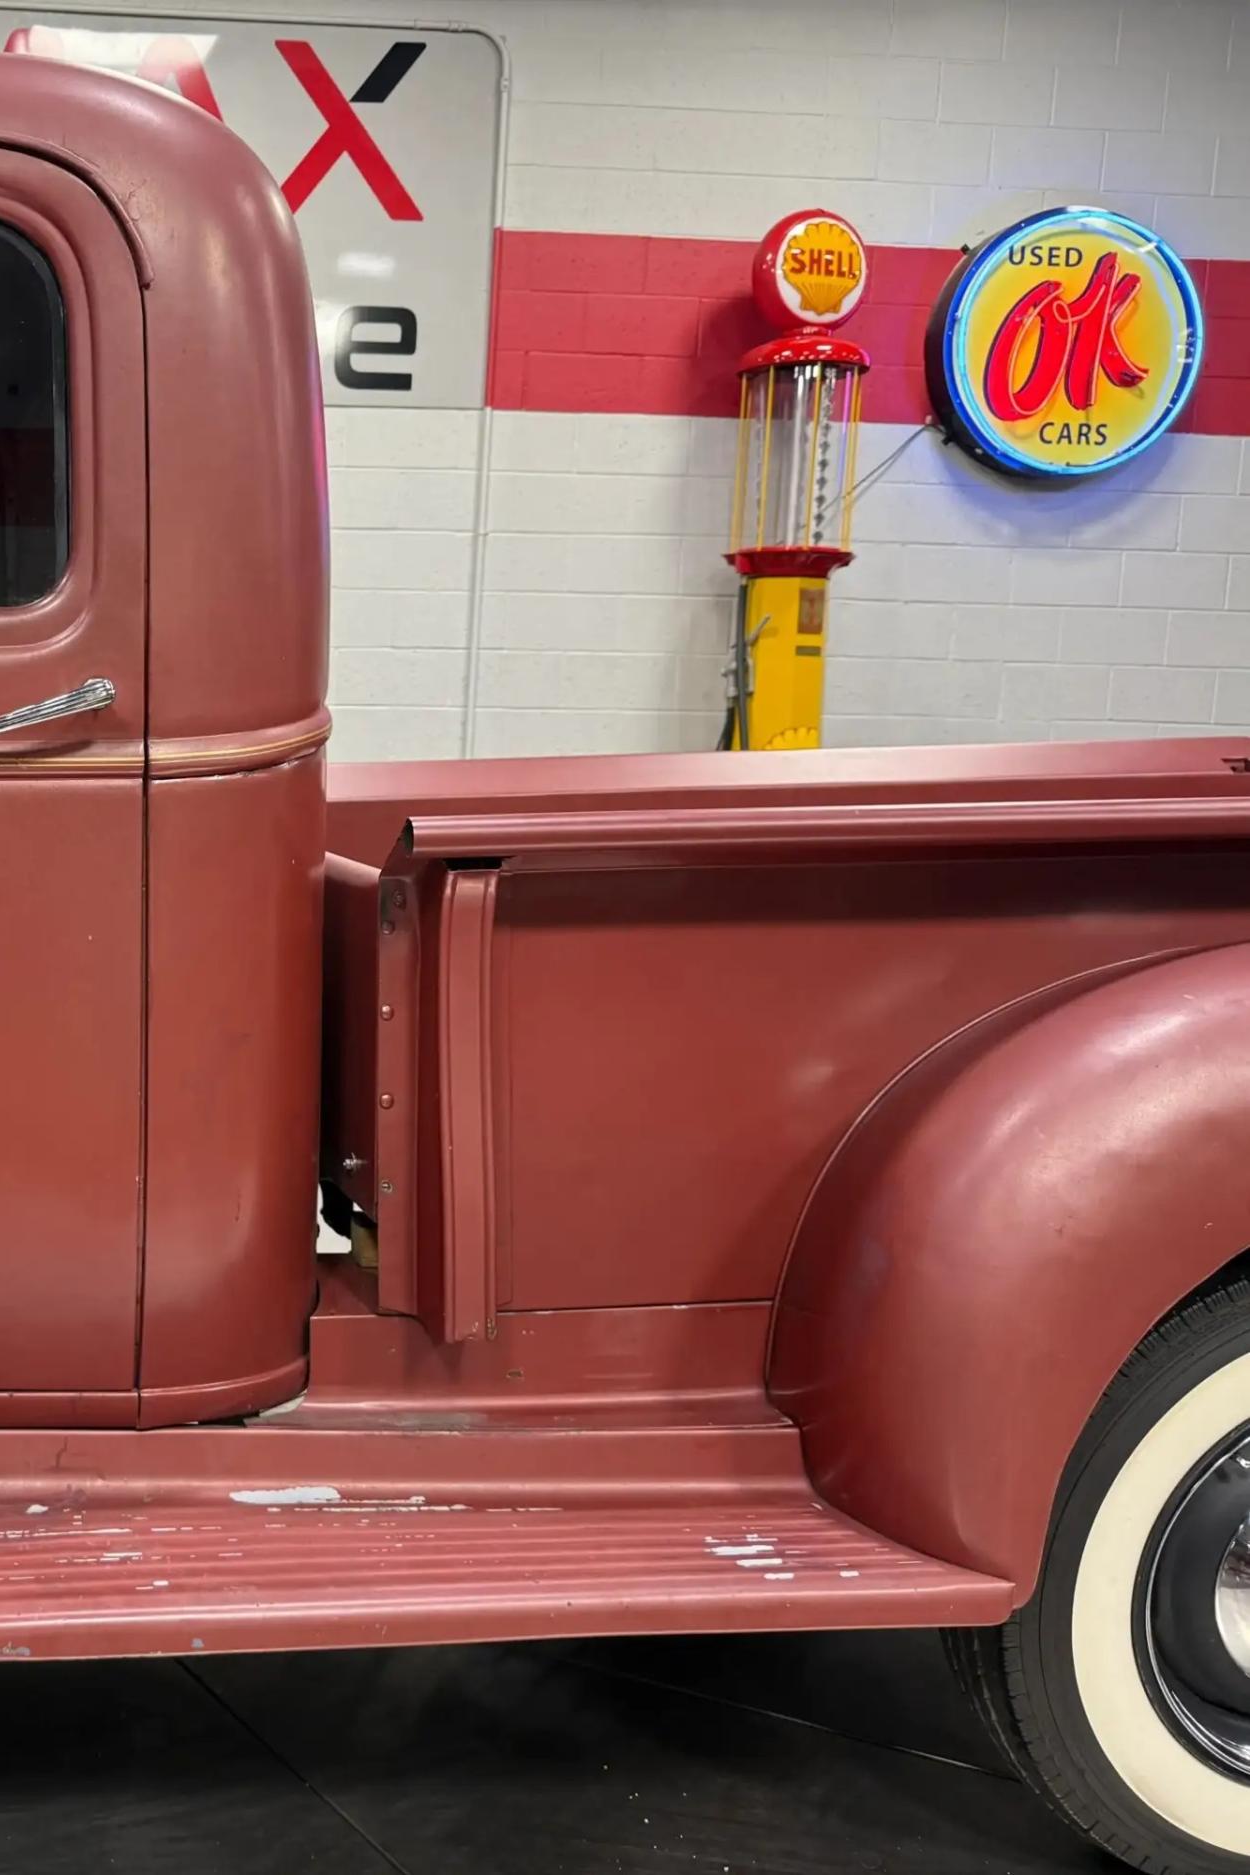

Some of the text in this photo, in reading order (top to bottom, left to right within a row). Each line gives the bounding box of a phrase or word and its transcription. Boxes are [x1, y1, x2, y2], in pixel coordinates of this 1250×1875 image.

[789, 247, 857, 280] SHELL
[1007, 245, 1084, 268] USED
[982, 251, 1150, 422] OK
[1038, 421, 1109, 447] CARS
